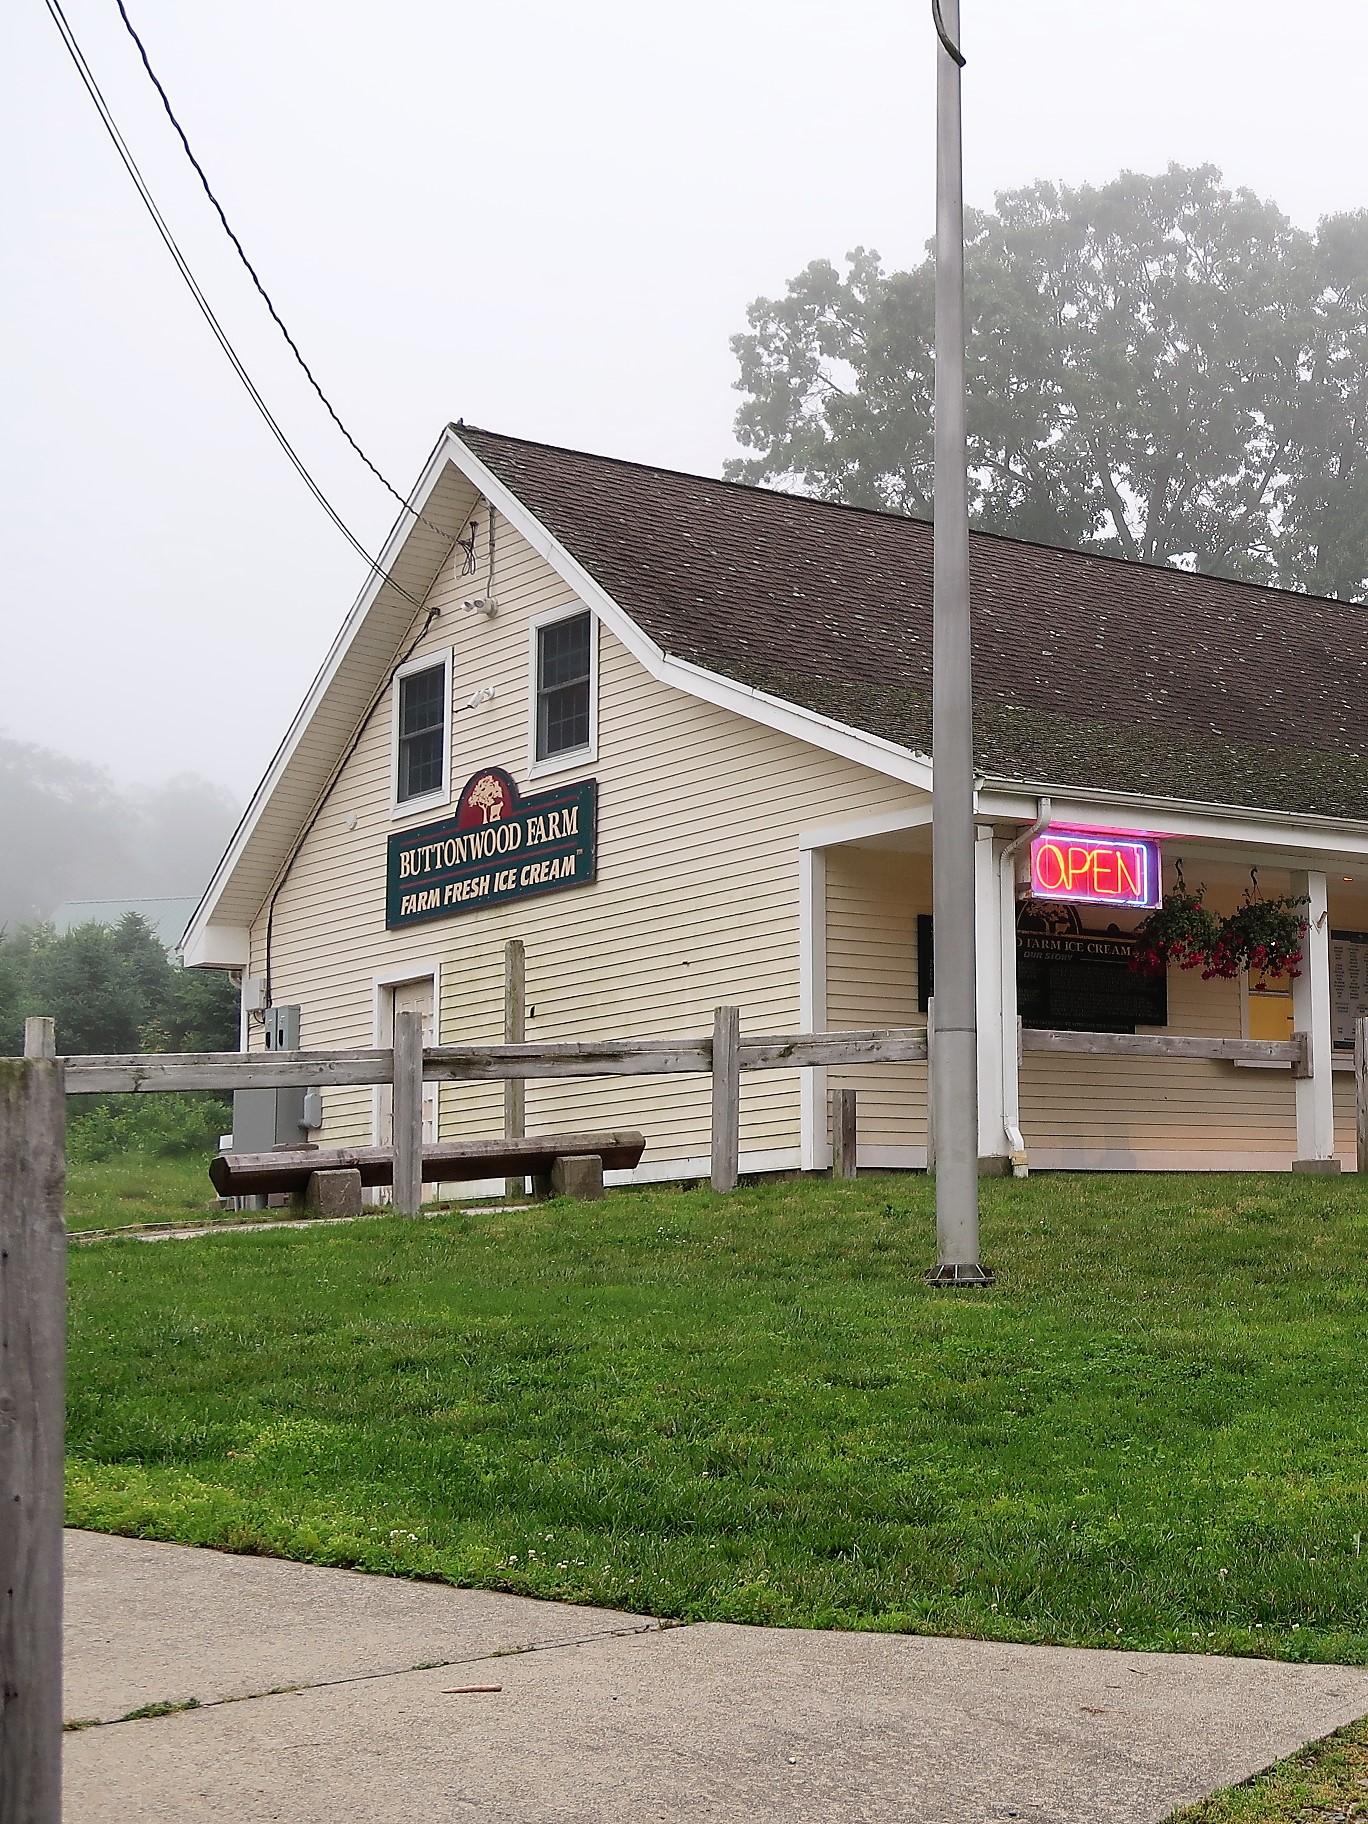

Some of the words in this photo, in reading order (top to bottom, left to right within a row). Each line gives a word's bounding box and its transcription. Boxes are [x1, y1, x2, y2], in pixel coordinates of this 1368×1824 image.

[399, 822, 522, 879] BUTTONWOOD
[525, 806, 579, 846] FARM
[400, 888, 440, 916] FARM
[443, 874, 490, 905] FRESH
[494, 868, 517, 893] ICE
[520, 855, 576, 886] CREAM
[1036, 844, 1141, 896] OPEN
[1023, 950, 1043, 960] OUR
[1044, 952, 1074, 961] STORY
[1065, 941, 1084, 953] ICE
[1087, 943, 1132, 956] CREAM
